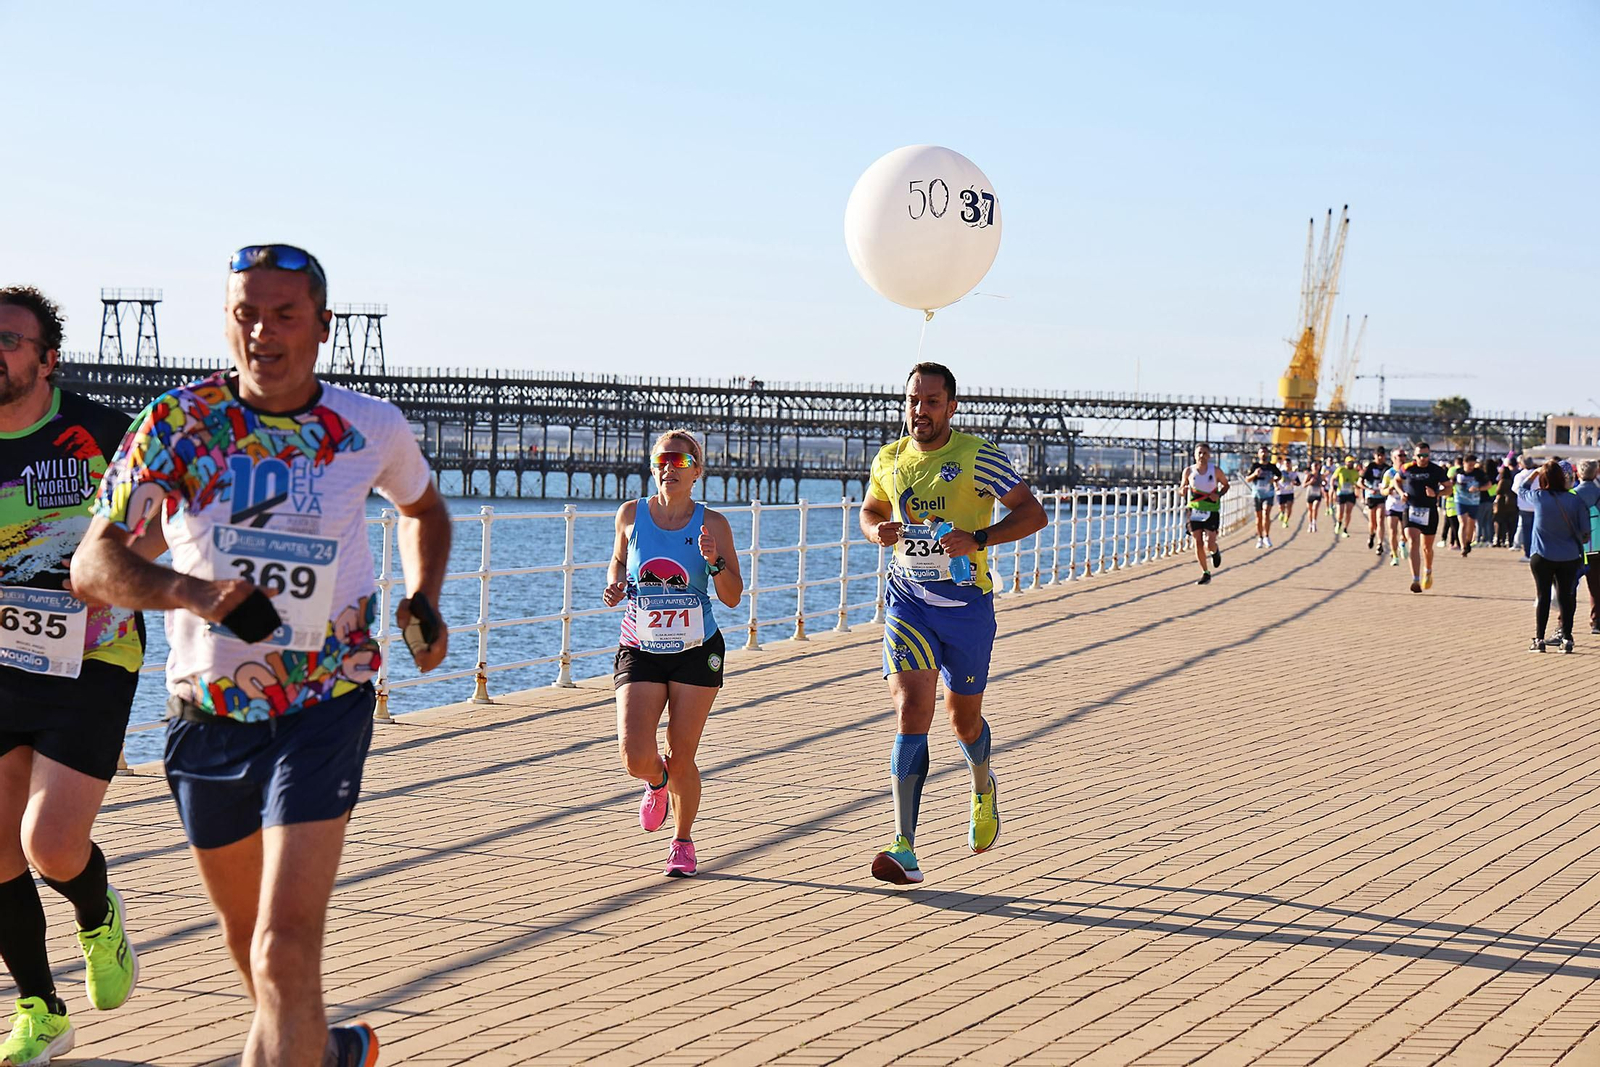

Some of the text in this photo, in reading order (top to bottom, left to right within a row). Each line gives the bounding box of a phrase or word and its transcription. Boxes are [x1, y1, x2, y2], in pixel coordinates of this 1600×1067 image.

[908, 178, 949, 219] 50
[35, 457, 78, 480] WILD
[37, 478, 79, 496] WORLD
[38, 492, 81, 508] TRAINING
[911, 496, 945, 511] Snell
[905, 540, 944, 556] 234
[231, 557, 317, 600] 369
[61, 596, 81, 609] '24
[1, 606, 68, 640] 635
[648, 610, 690, 628] 271
[650, 640, 680, 649] Wayalia
